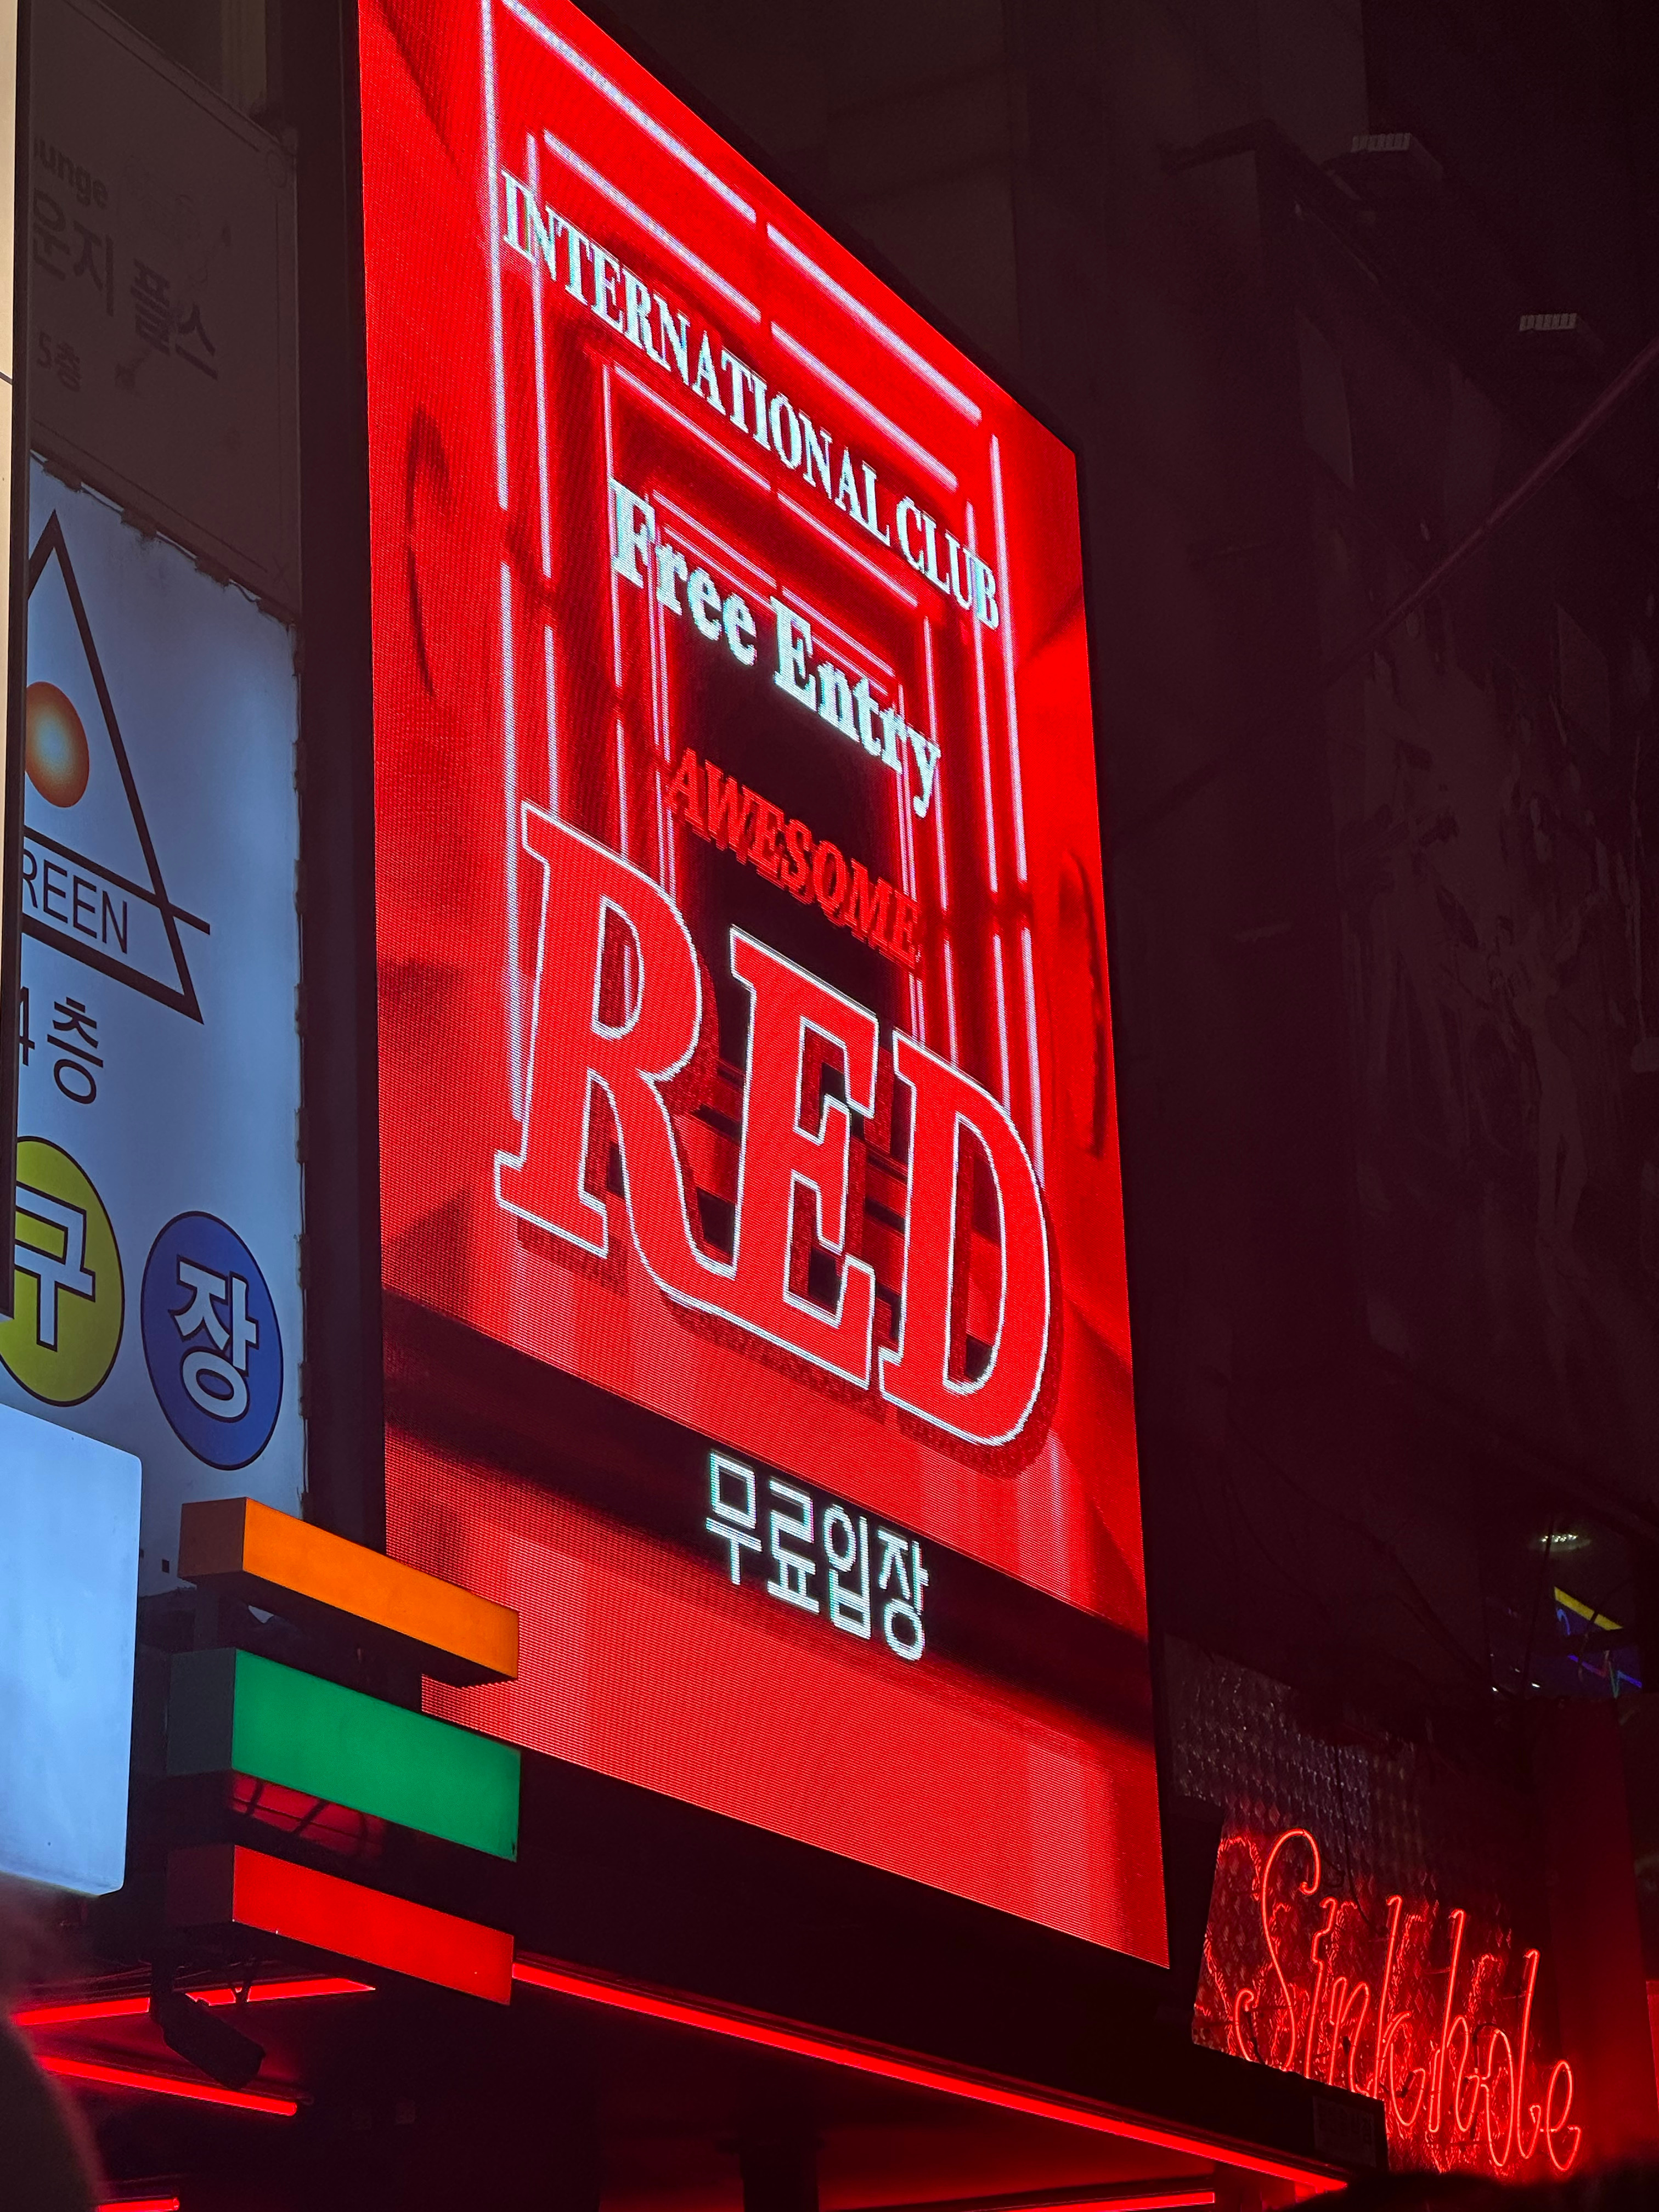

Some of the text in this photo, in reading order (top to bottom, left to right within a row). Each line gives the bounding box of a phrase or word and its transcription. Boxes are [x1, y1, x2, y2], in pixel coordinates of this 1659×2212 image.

[502, 169, 1000, 631] INTERNATIONAL CLUB
[608, 476, 941, 820] Free Entry
[666, 747, 923, 968] AWESOME
[493, 801, 1050, 1446] RED
[704, 1448, 930, 1662] 무료입장
[1234, 1827, 1582, 2172] Sinkhole
